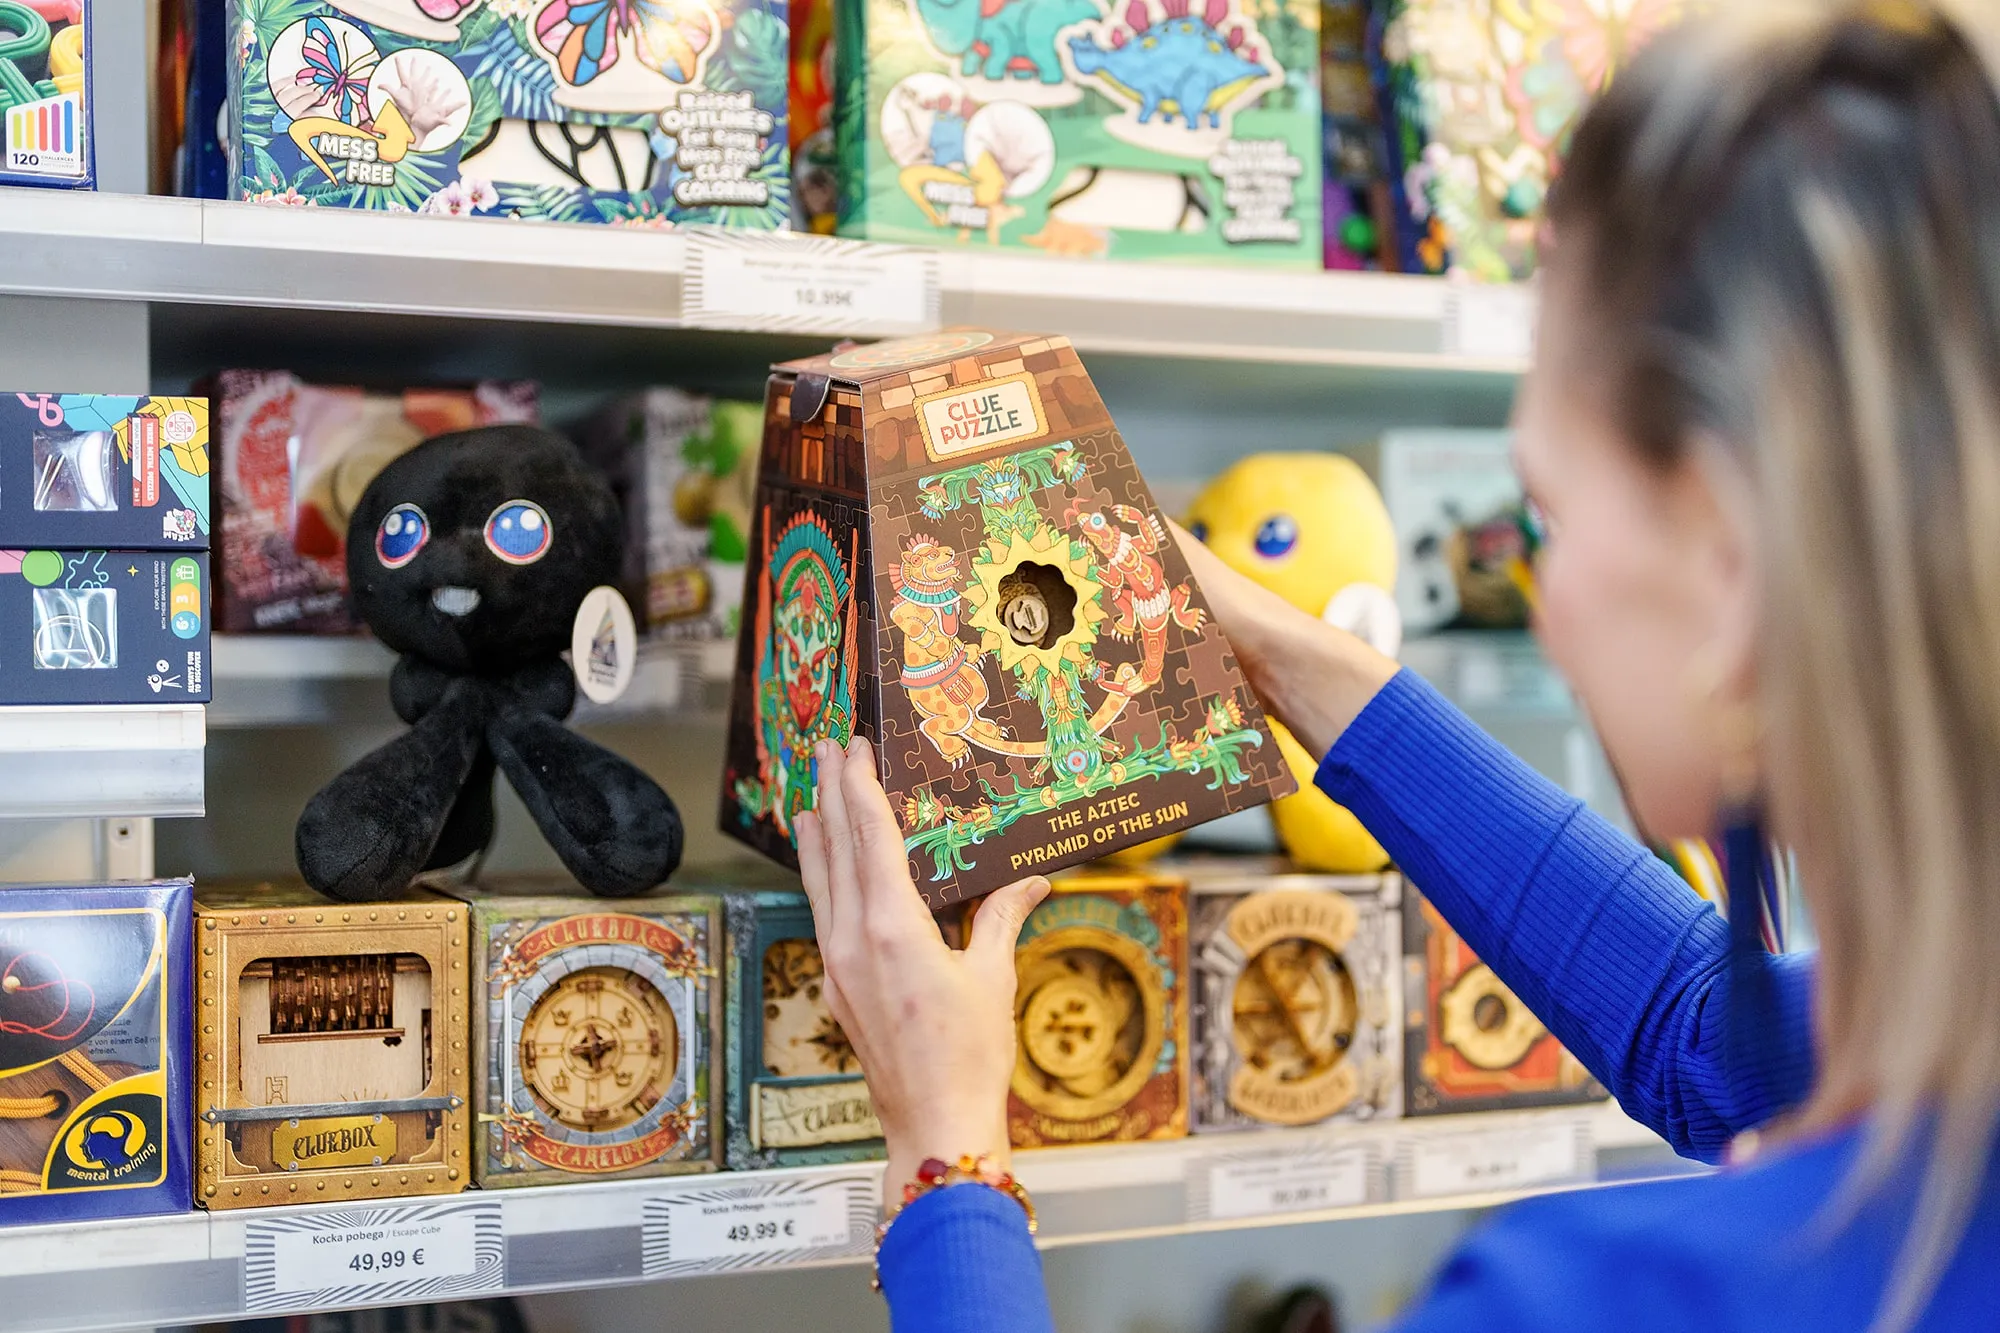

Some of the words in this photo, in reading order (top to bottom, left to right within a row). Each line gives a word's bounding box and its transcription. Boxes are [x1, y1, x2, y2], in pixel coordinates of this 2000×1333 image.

[13, 153, 39, 166] 120
[319, 133, 377, 161] MESS
[347, 160, 394, 185] FREE
[948, 393, 1003, 422] CLUE
[940, 409, 1022, 445] PUZZLE
[187, 651, 195, 665] FUN
[187, 665, 195, 693] ALWAYS
[1047, 809, 1083, 834] THE
[1086, 792, 1141, 822] AZTEC
[1010, 836, 1090, 871] PYRAMID
[1092, 824, 1116, 845] OF
[1118, 812, 1153, 838] THE
[1155, 801, 1189, 826] SUN
[292, 1123, 380, 1161] CLUEBOX
[66, 1167, 110, 1182] mental
[113, 1142, 157, 1177] training
[312, 1233, 343, 1245] Kocka
[346, 1229, 384, 1244] pobega
[392, 1227, 419, 1239] Escape
[420, 1224, 442, 1236] Cube
[727, 1222, 777, 1242] 49,99
[783, 1219, 795, 1237] €
[348, 1250, 406, 1273] 49,99
[411, 1247, 426, 1266] €
